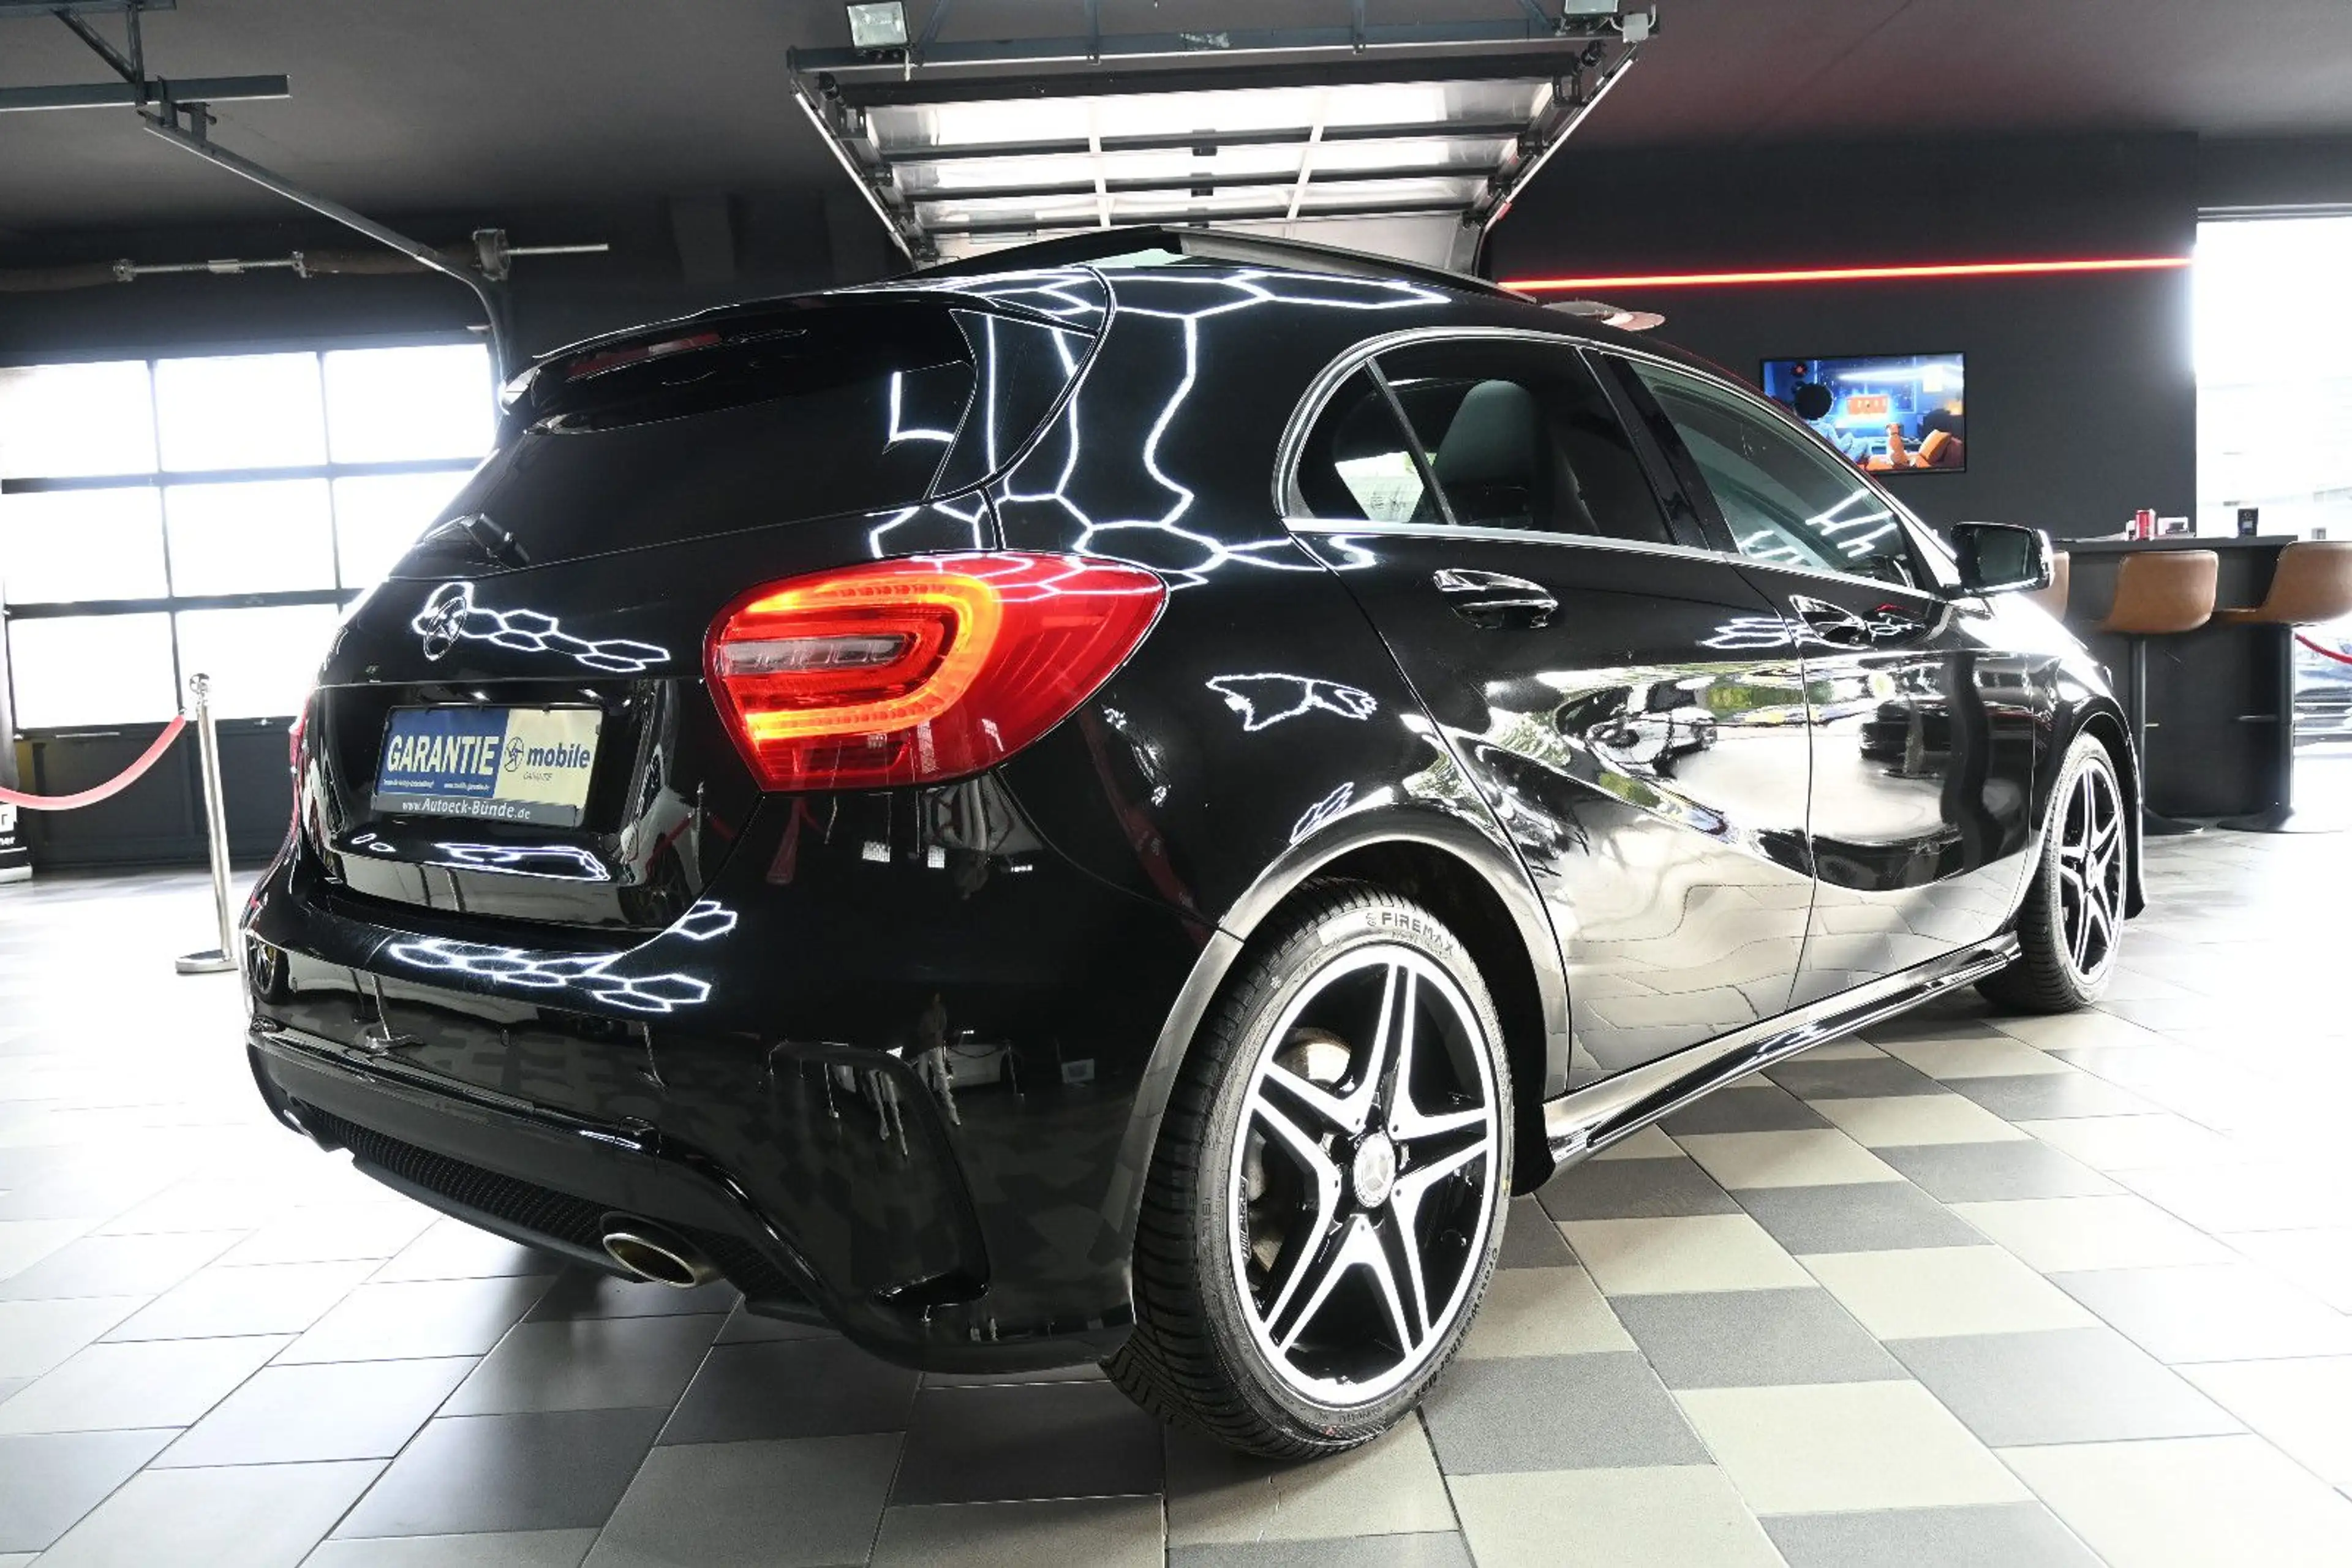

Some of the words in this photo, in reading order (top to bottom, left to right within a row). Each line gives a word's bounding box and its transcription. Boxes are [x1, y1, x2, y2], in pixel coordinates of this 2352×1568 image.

[387, 735, 499, 775] GARANTIE
[527, 742, 590, 769] mobile
[402, 798, 530, 820] www.Autoeck-Bünde.de
